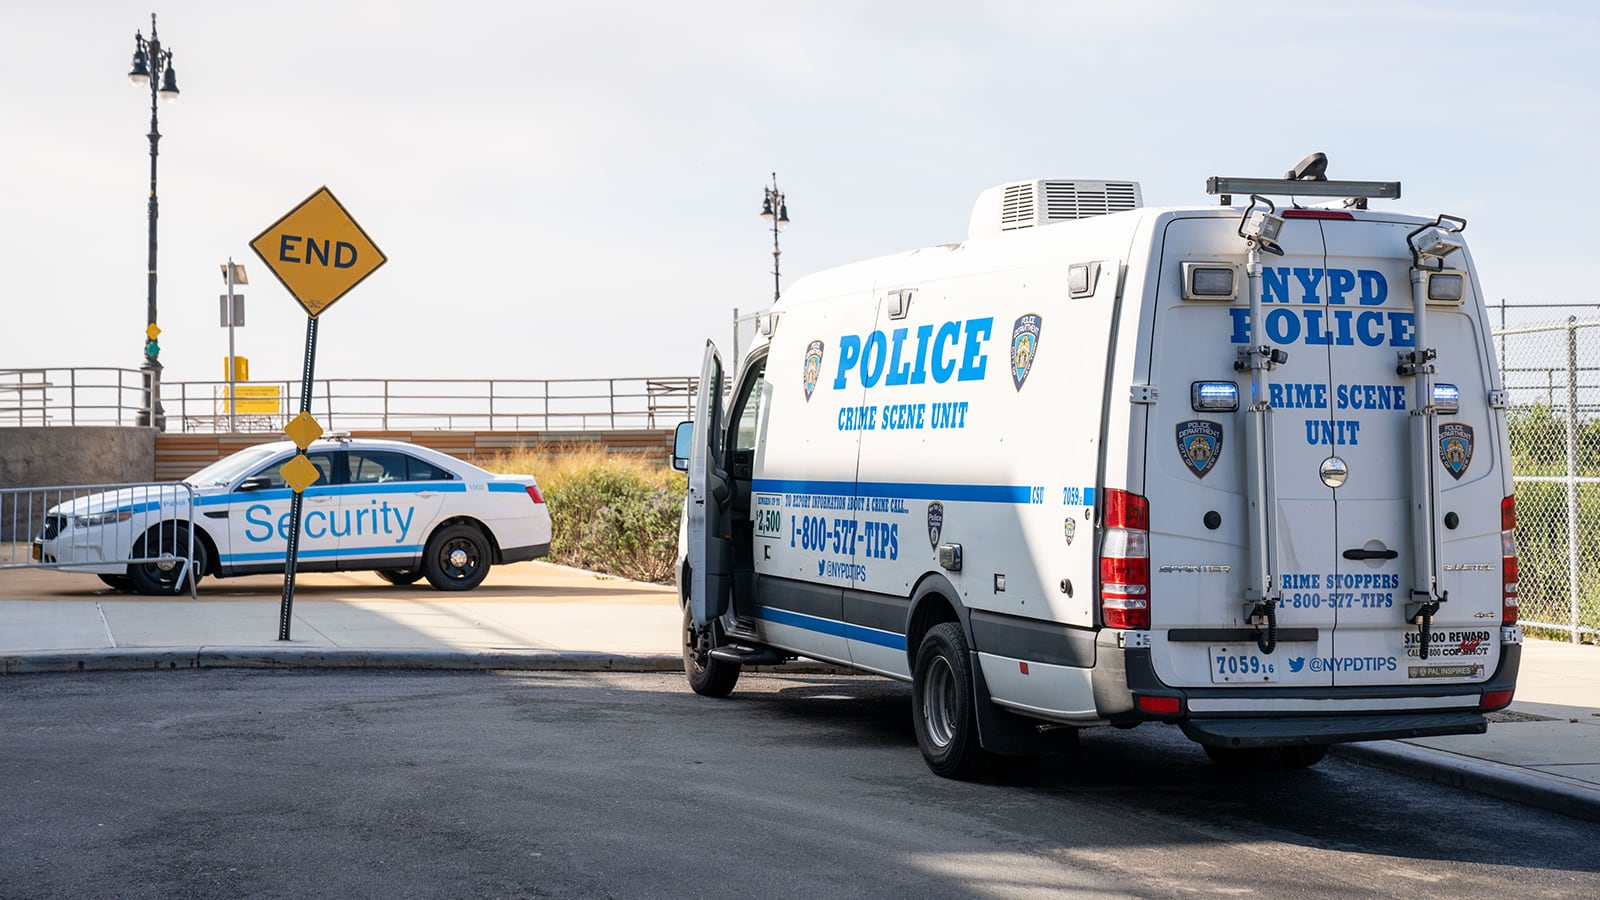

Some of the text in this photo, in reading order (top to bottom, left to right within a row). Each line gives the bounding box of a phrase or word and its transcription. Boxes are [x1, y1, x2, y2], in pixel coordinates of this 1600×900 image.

[279, 234, 358, 269] END
[1260, 267, 1388, 306] NYPD
[1229, 308, 1415, 347] POLICE
[833, 317, 994, 390] POLICE
[1268, 383, 1406, 410] RIME SCENE
[838, 401, 969, 431] CRIME SCENE UNIT
[1178, 427, 1220, 439] DEPARTMENT
[1305, 420, 1360, 446] UNIT
[792, 495, 811, 509] REPORT
[812, 496, 846, 511] INFORMATION
[847, 497, 866, 512] ABOUT
[1032, 486, 1045, 505] CSU
[1062, 487, 1079, 506] 7059
[245, 500, 415, 543] Security
[756, 509, 781, 535] $2,500
[790, 514, 899, 561] 1-800-577-TIPS
[826, 560, 867, 582] @NYPDTIPS
[1159, 565, 1231, 573] SPRINTER
[1281, 574, 1399, 589] RIME STOPPERS
[1279, 592, 1393, 609] 1-800-577-TIPS
[1449, 631, 1490, 642] REWARD
[1216, 655, 1274, 674] 7059 16
[1309, 656, 1397, 672] @NYPDTIPS
[1427, 667, 1471, 675] PAL INSPIRES
